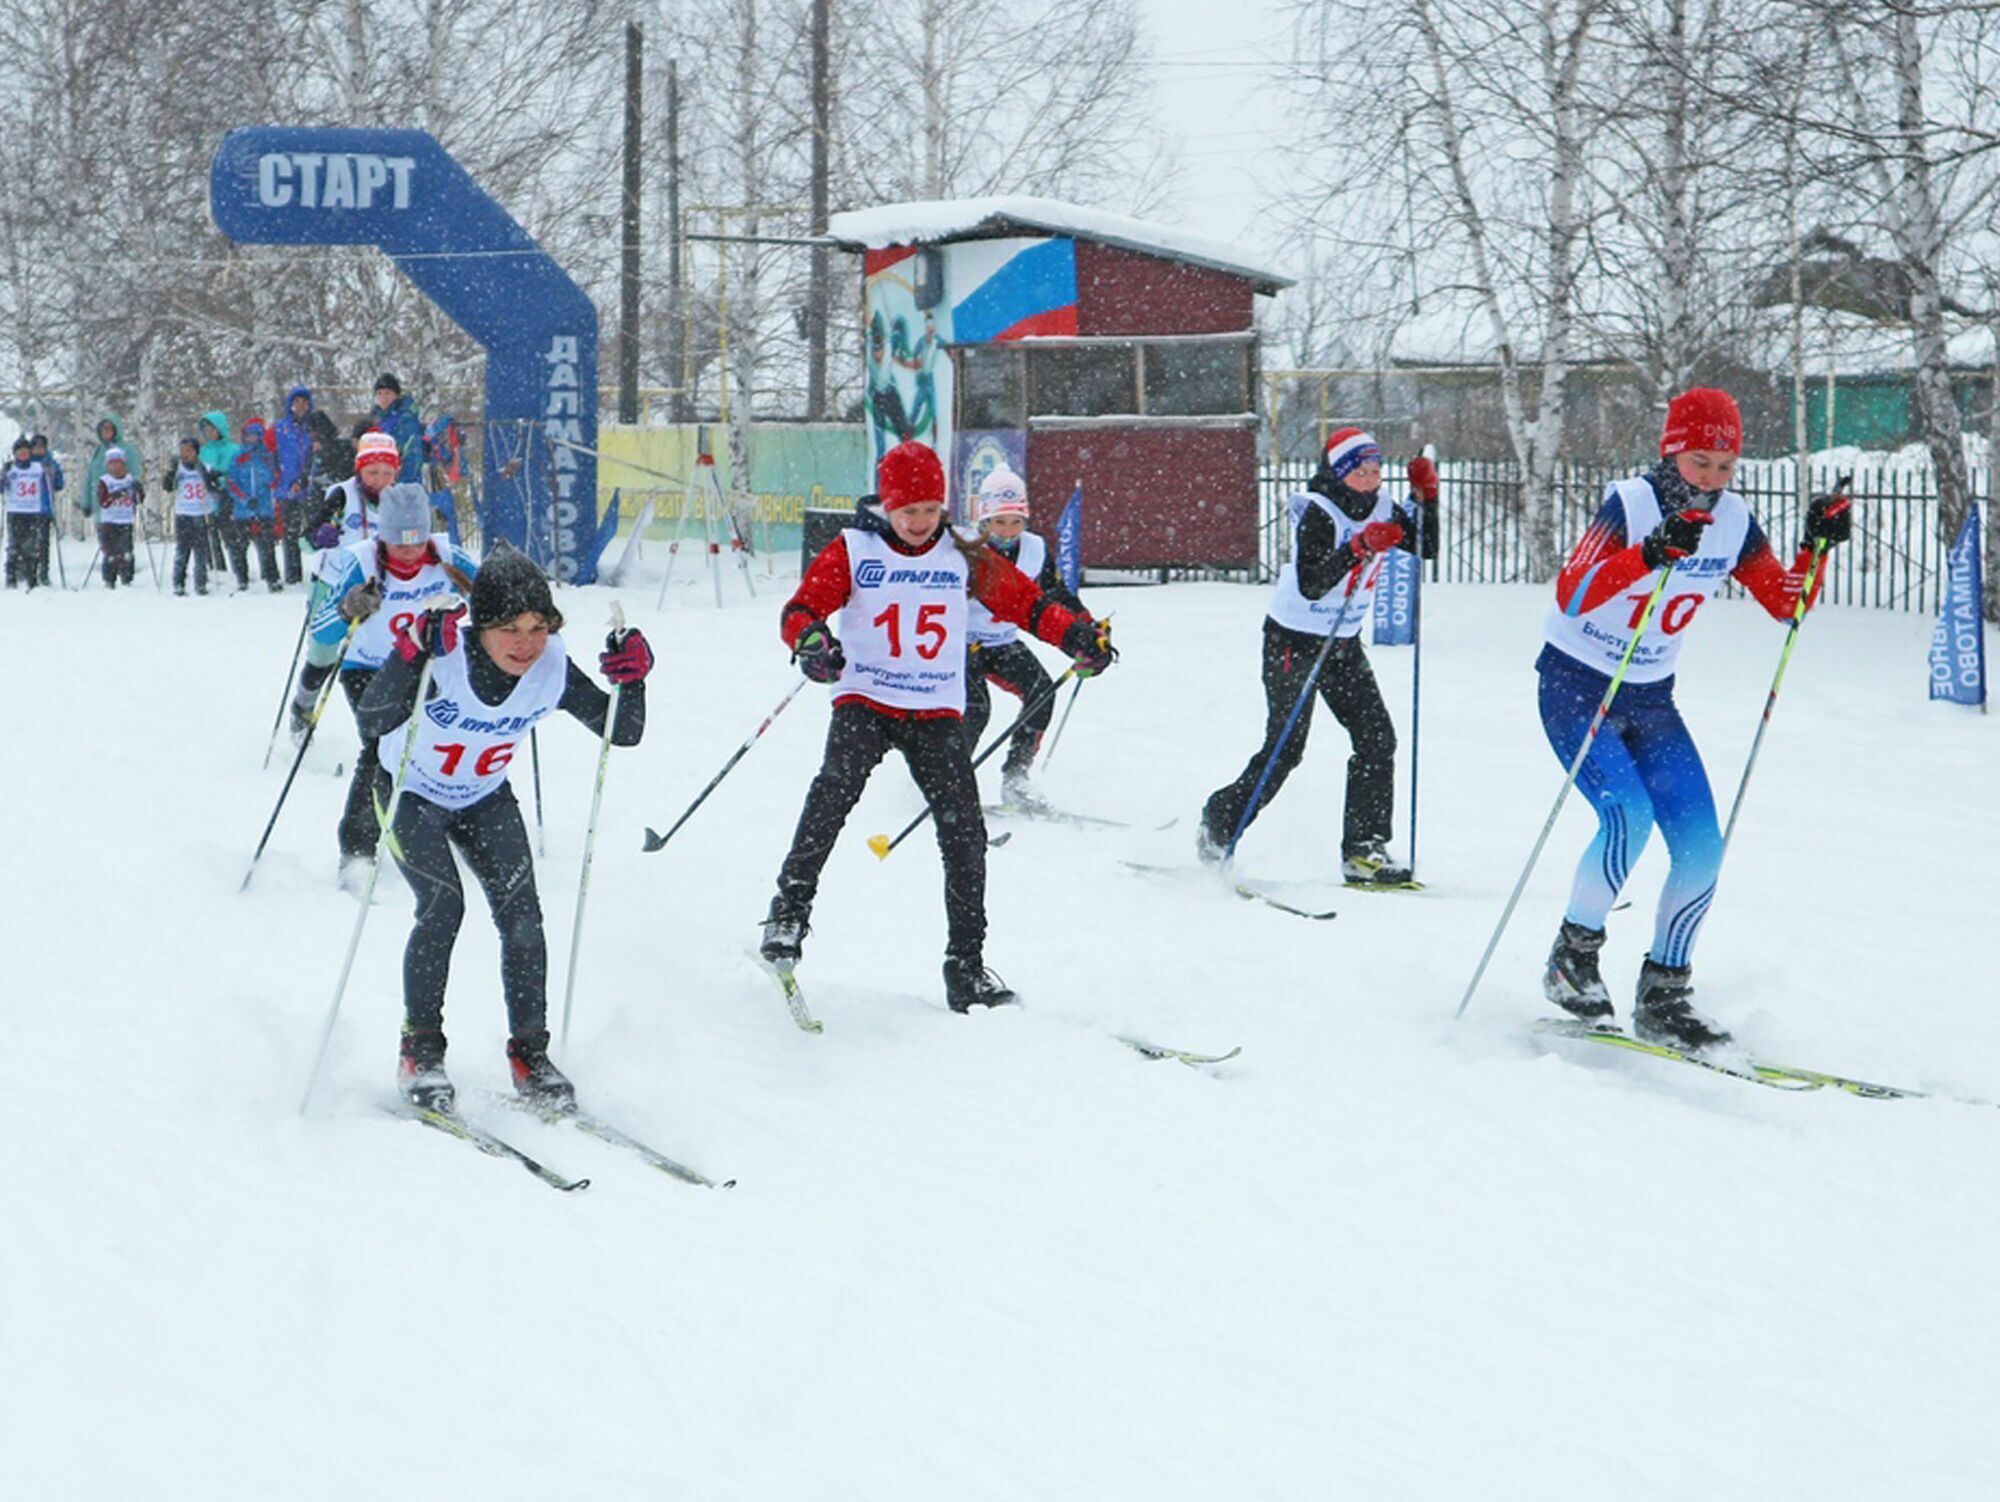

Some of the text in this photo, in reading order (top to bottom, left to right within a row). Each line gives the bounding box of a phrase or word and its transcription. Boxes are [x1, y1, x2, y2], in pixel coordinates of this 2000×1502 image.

[259, 152, 416, 209] СТАРТ
[545, 334, 583, 579] ДАЛМАТОВО
[873, 602, 948, 661] 15
[1626, 591, 1705, 636] 10
[432, 741, 516, 777] 16
